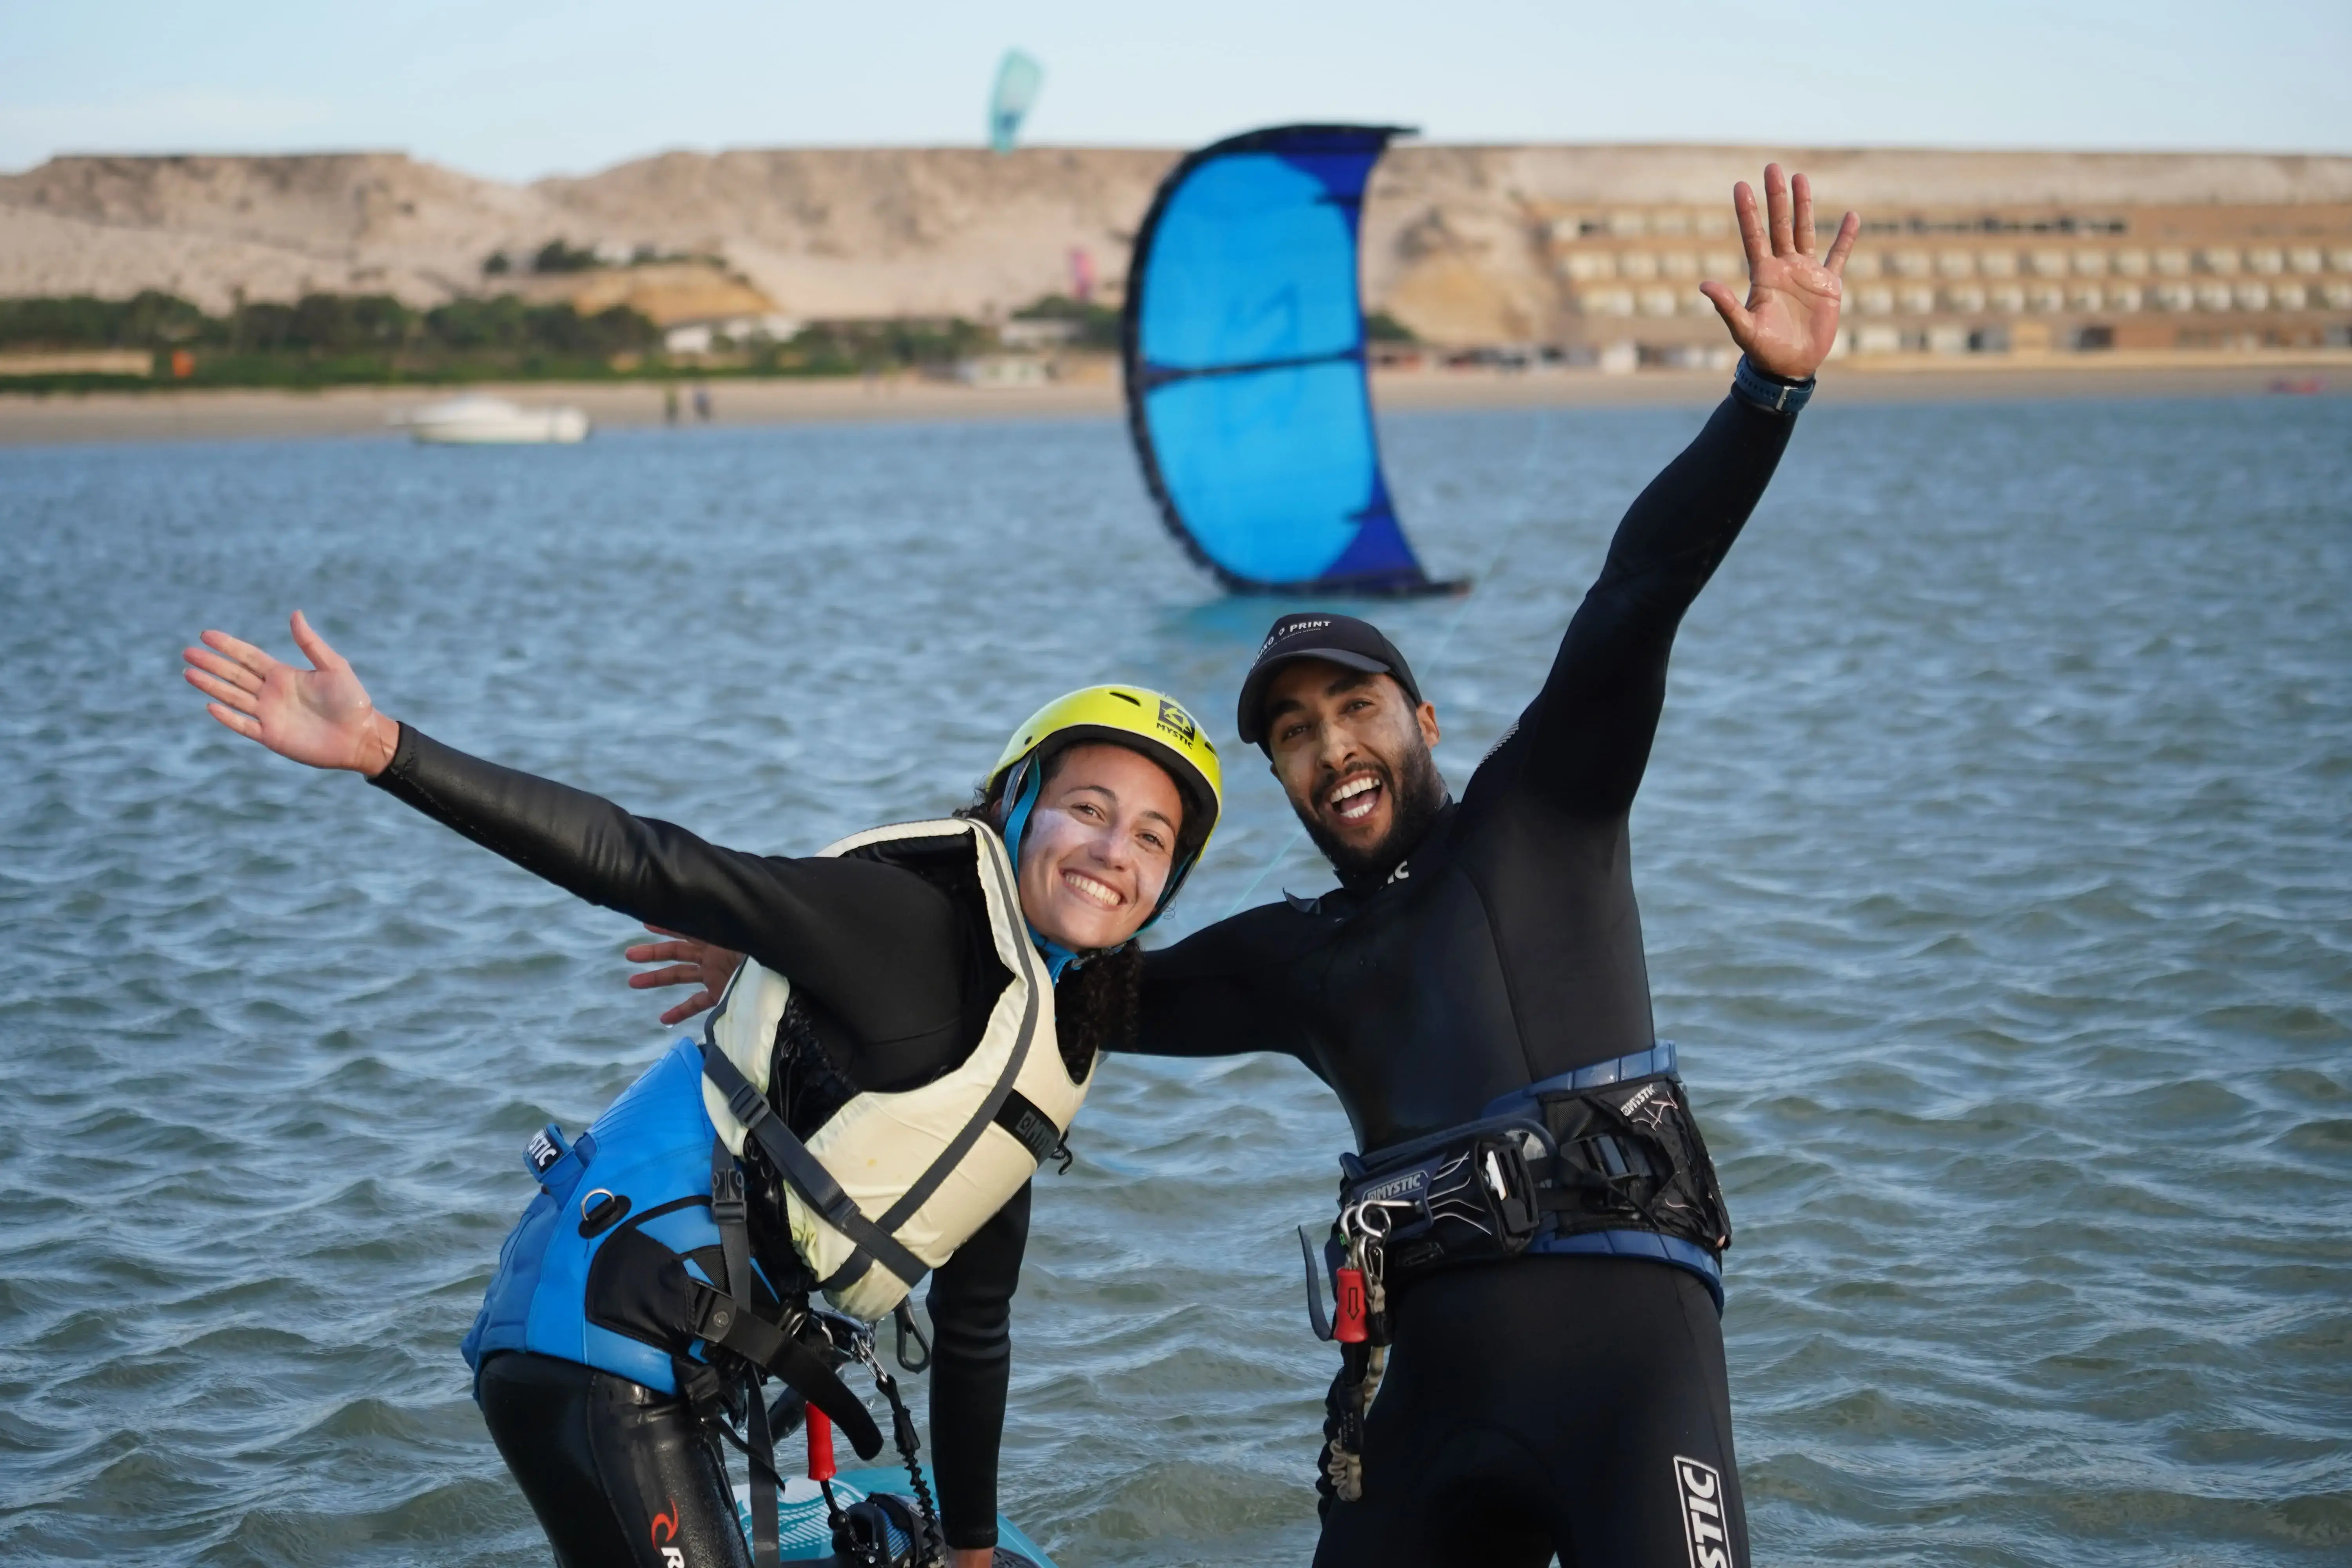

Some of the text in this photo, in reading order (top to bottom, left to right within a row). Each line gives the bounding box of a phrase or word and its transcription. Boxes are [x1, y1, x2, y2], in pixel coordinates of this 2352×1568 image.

[1290, 621, 1331, 632] PRINT
[1156, 722, 1193, 750] MYSTIC
[1626, 1083, 1656, 1111] MYSTIC
[1377, 1174, 1421, 1200] MYSTIC
